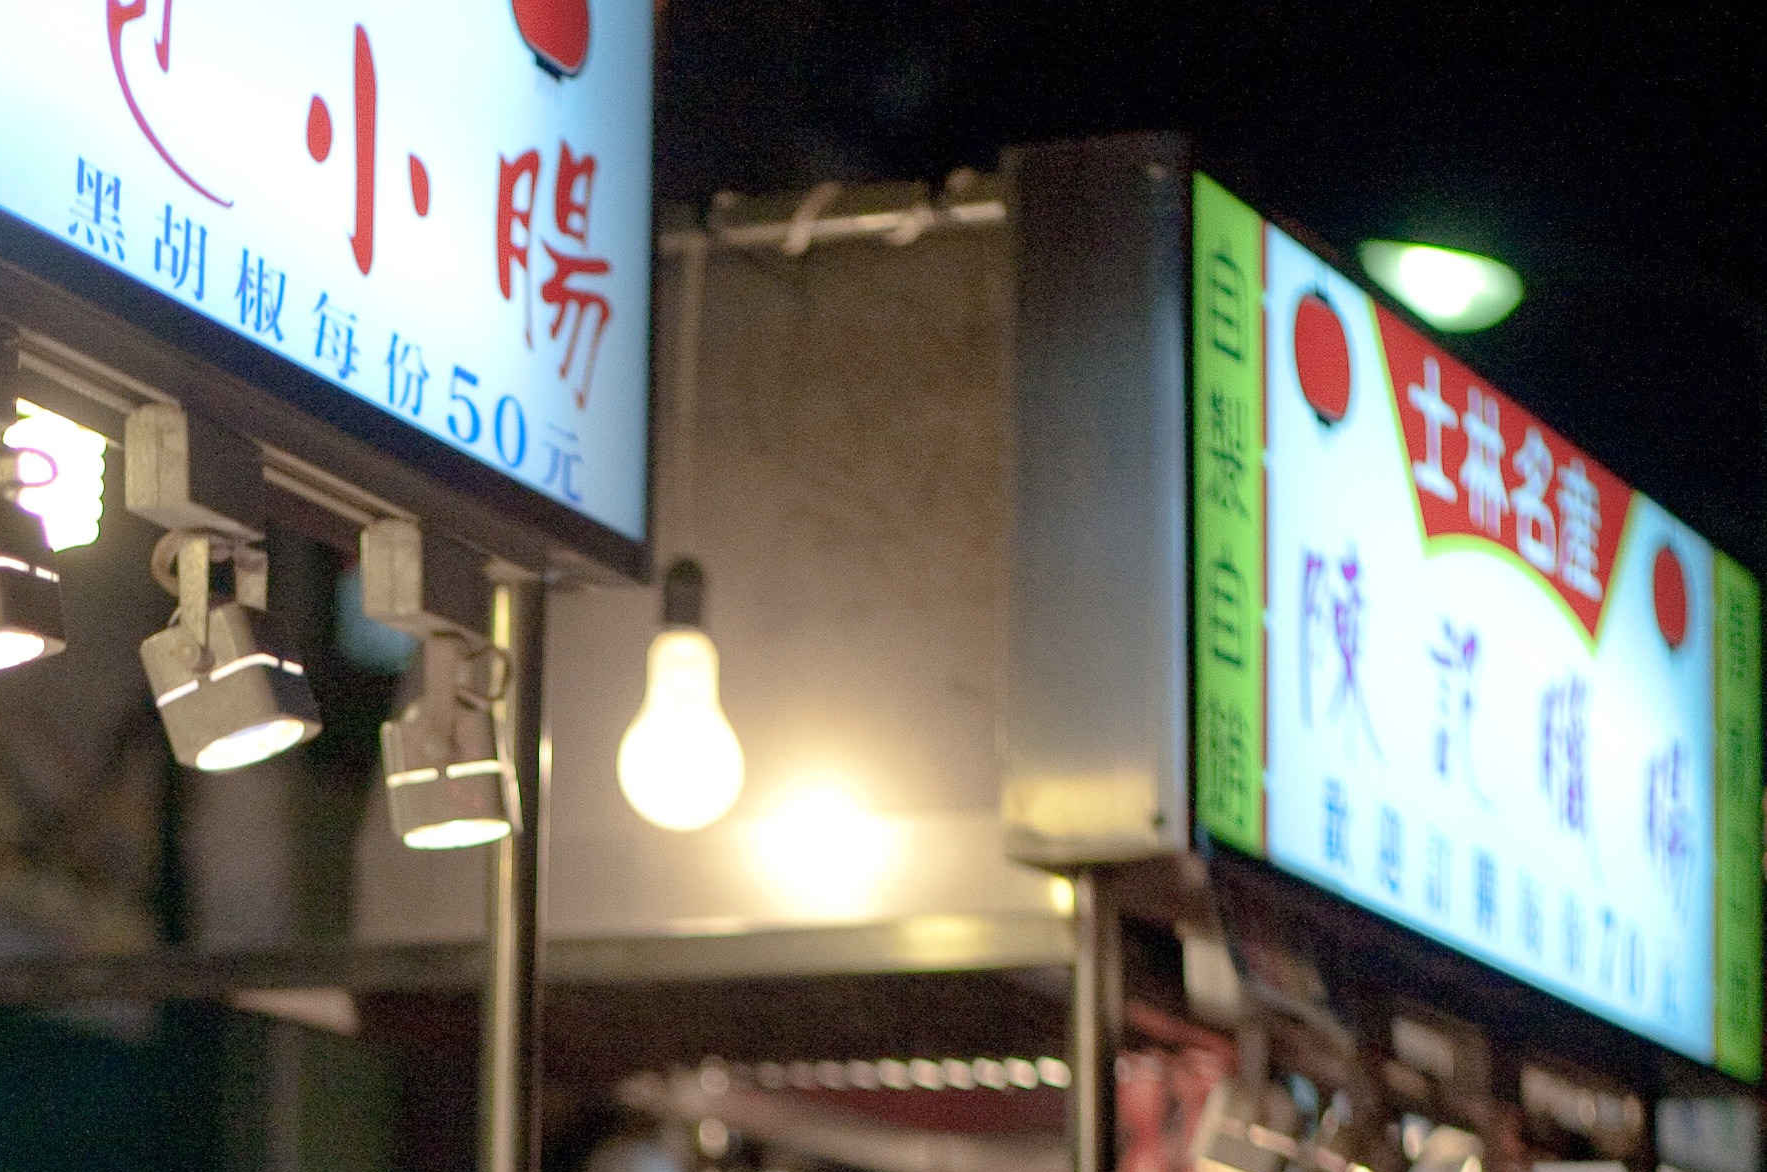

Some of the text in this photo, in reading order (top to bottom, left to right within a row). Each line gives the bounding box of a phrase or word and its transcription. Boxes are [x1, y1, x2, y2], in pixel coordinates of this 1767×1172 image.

[69, 156, 585, 506] 黑胡椒每份50元
[1407, 356, 1604, 601] 士林名產
